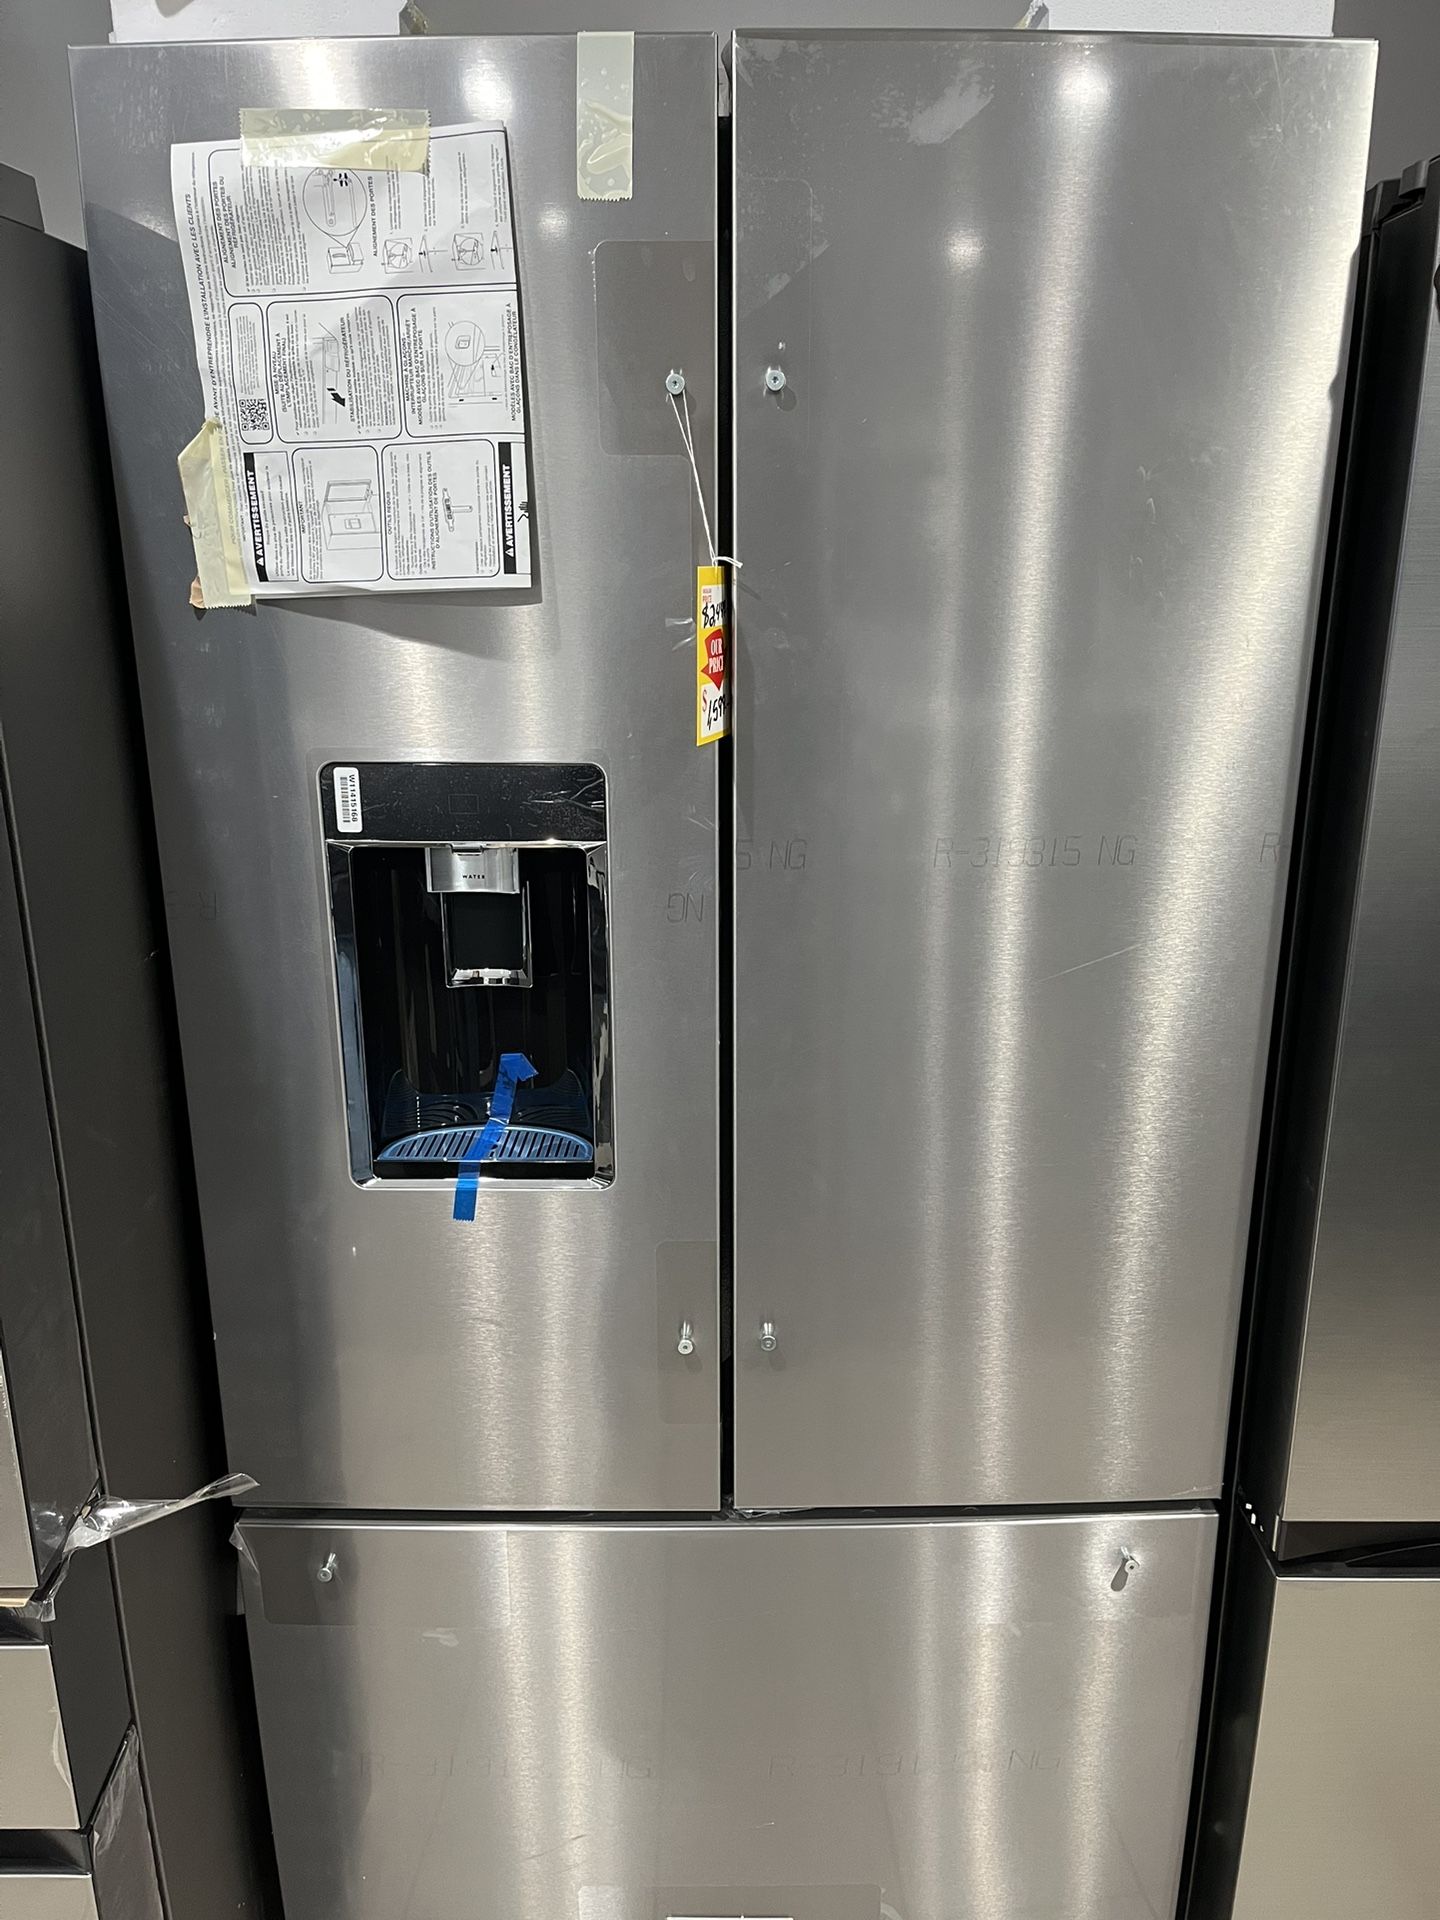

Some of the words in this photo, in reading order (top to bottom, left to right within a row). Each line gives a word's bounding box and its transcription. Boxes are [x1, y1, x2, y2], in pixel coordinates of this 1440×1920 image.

[185, 193, 194, 225] CLIENTS
[212, 181, 220, 206] PORTES
[192, 242, 200, 262] AVEC
[216, 222, 228, 264] ALIGNEMENT
[196, 263, 210, 320] L'INSTALLATION
[204, 322, 216, 386] D'ENTREPRENDRE
[246, 470, 264, 556] AVERTISSEMENT
[502, 464, 514, 547] AVERTISSEMENT
[710, 638, 722, 656] OUR
[769, 838, 808, 870] NG
[1097, 835, 1138, 867] NG
